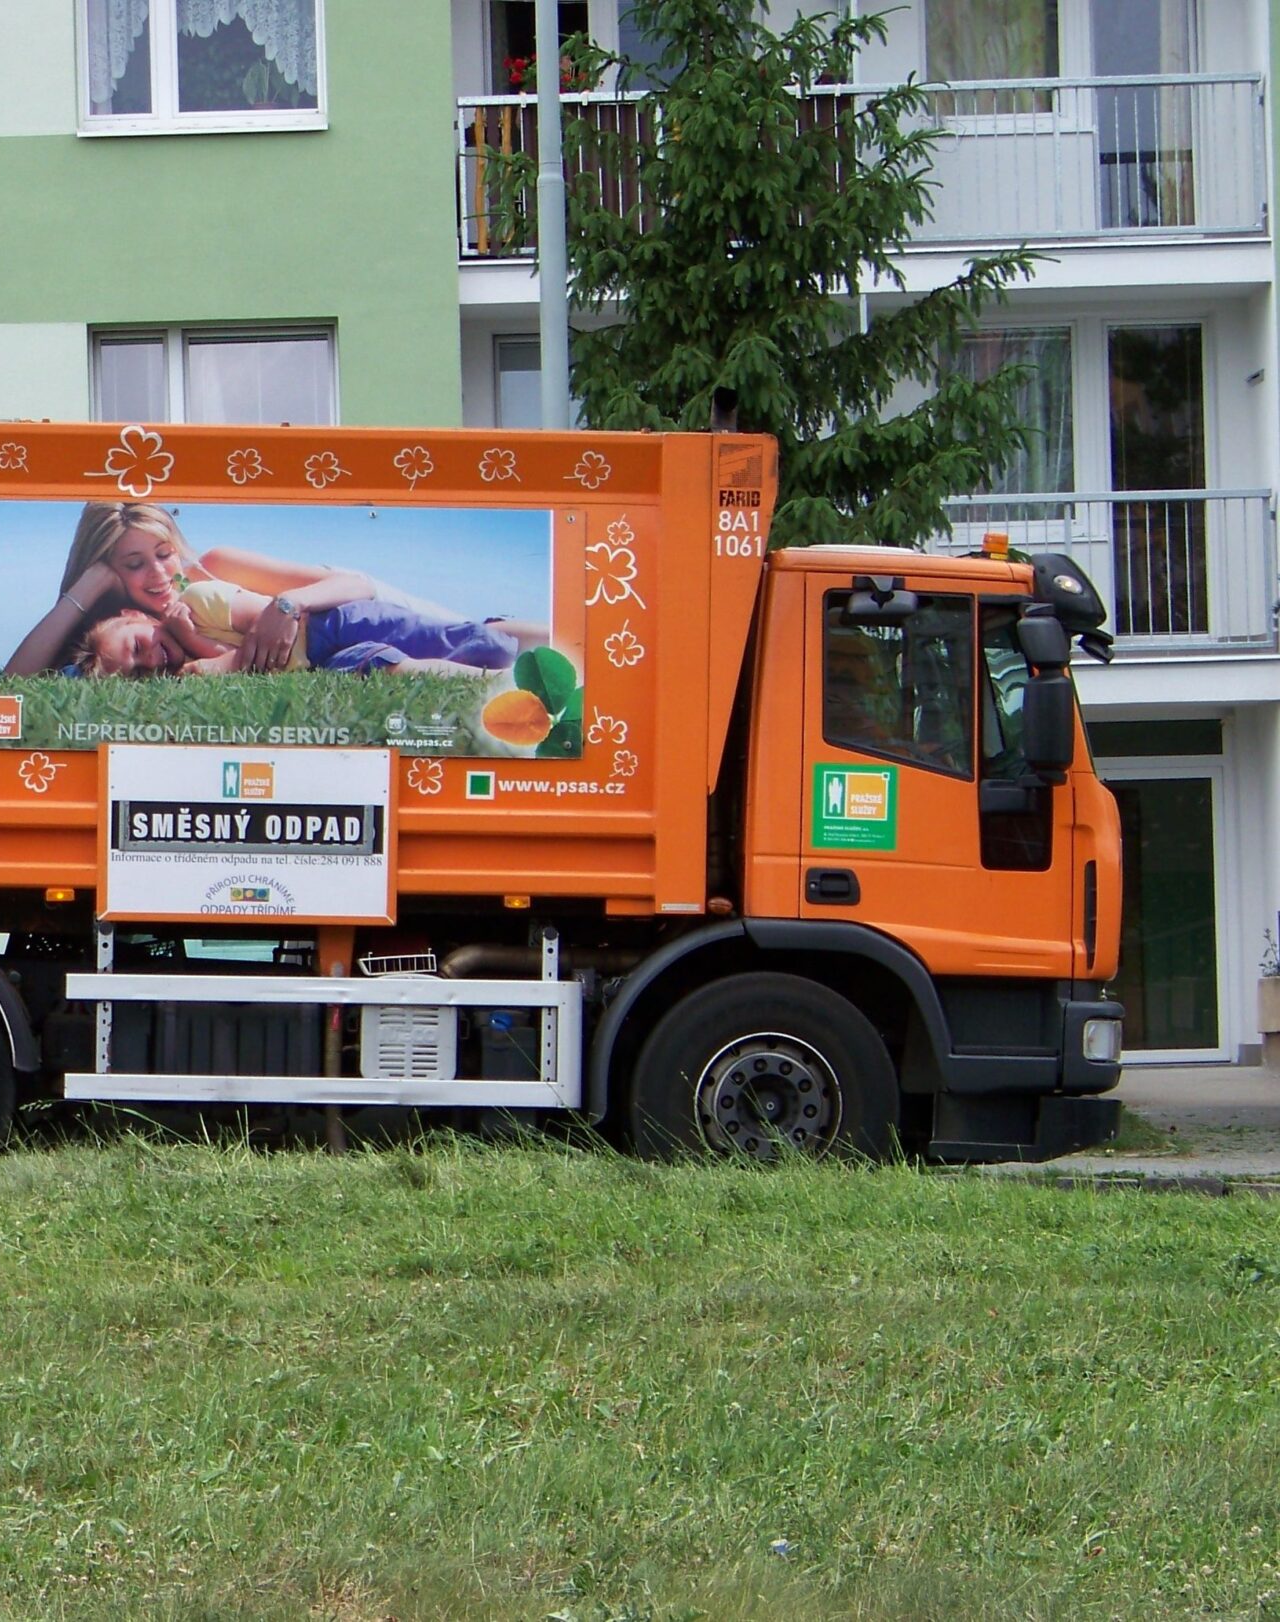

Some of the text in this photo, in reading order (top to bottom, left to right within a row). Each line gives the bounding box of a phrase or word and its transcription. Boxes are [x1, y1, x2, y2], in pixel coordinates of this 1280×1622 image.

[719, 490, 761, 507] FARID
[718, 510, 759, 532] 8A1
[714, 535, 762, 557] 1061
[58, 719, 350, 745] NEPŘEKONATELNÝ SERVIS
[386, 738, 454, 748] www.psas.cz
[498, 779, 625, 796] www.psas.cz
[133, 808, 361, 842] SMĚSNÝ ODPAD
[111, 852, 161, 863] Informace
[164, 854, 171, 863] o
[174, 853, 218, 864] tříděném
[221, 854, 258, 866] odpadu
[260, 856, 273, 865] na
[341, 855, 360, 866] 091
[363, 856, 383, 867] 888
[205, 874, 295, 905] PŘÍRODU CHRÁNÍME
[200, 904, 248, 914] ODPADY
